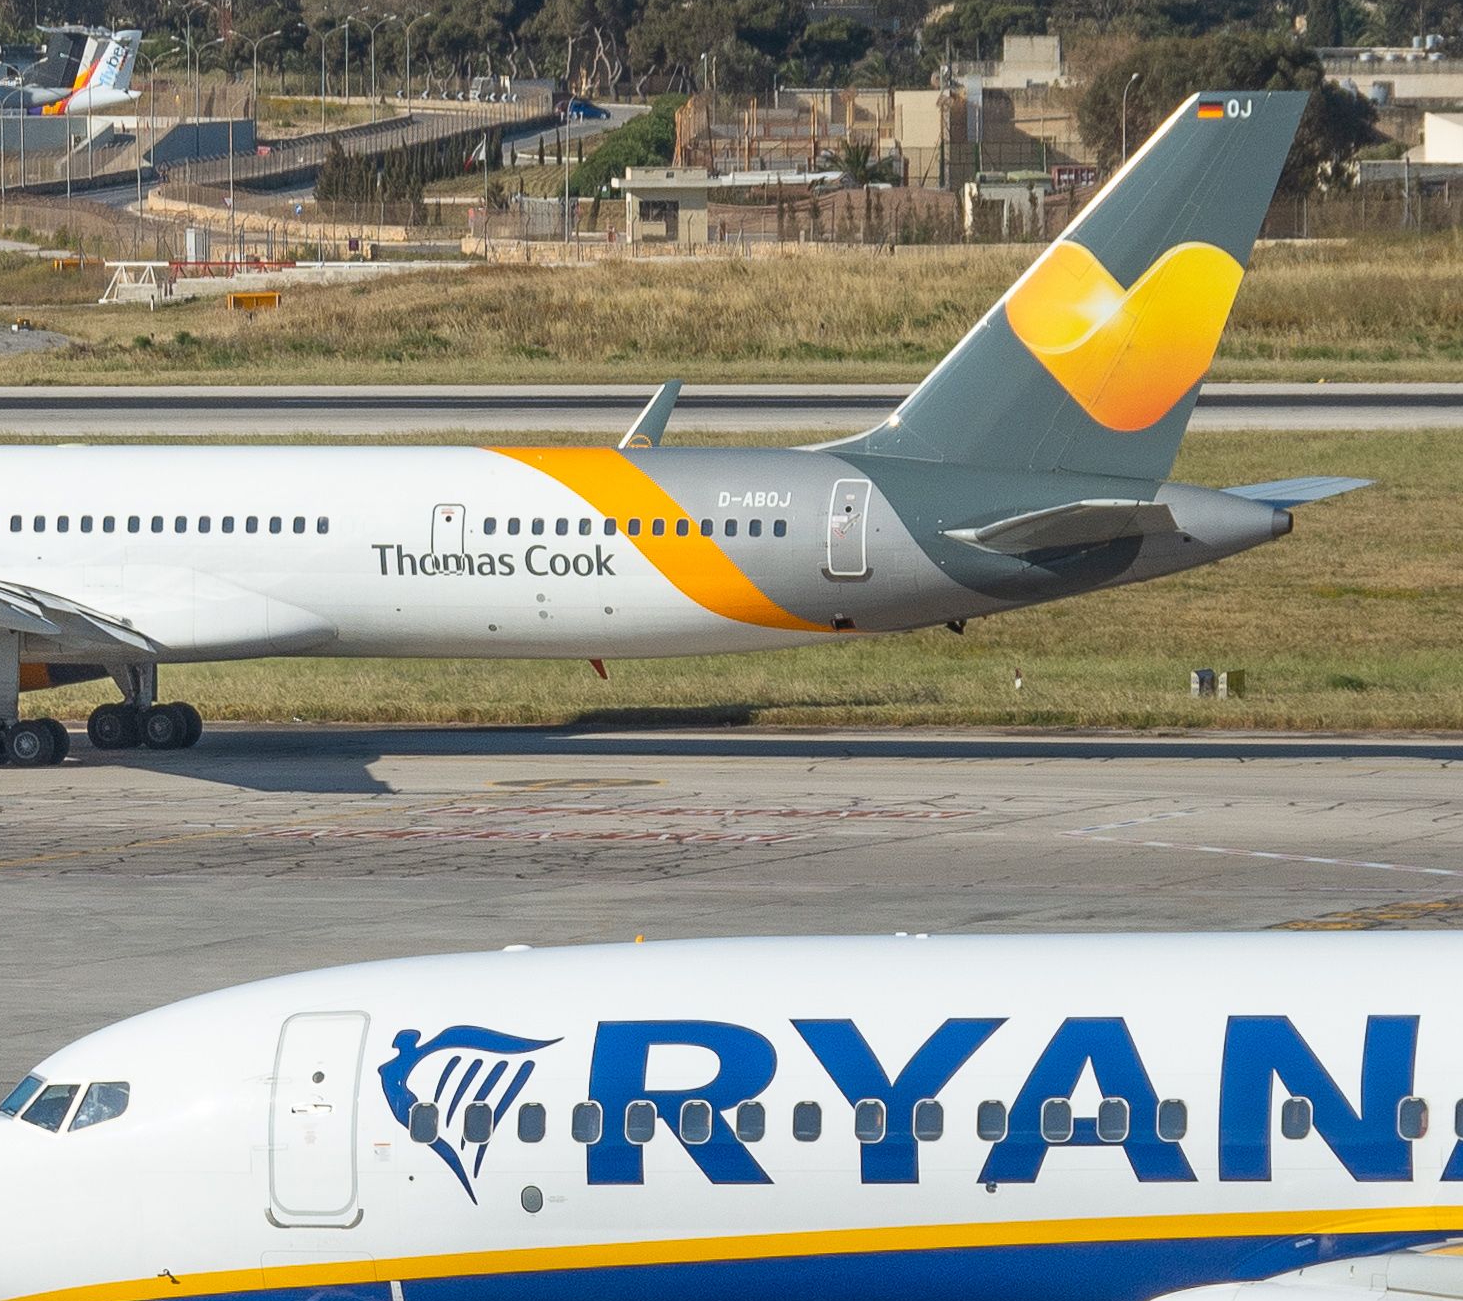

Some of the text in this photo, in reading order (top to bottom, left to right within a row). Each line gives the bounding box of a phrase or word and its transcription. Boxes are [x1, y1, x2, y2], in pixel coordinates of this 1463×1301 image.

[1227, 98, 1253, 118] OJ
[718, 491, 792, 508] D-ABOJ
[372, 543, 615, 577] Thomas Cook
